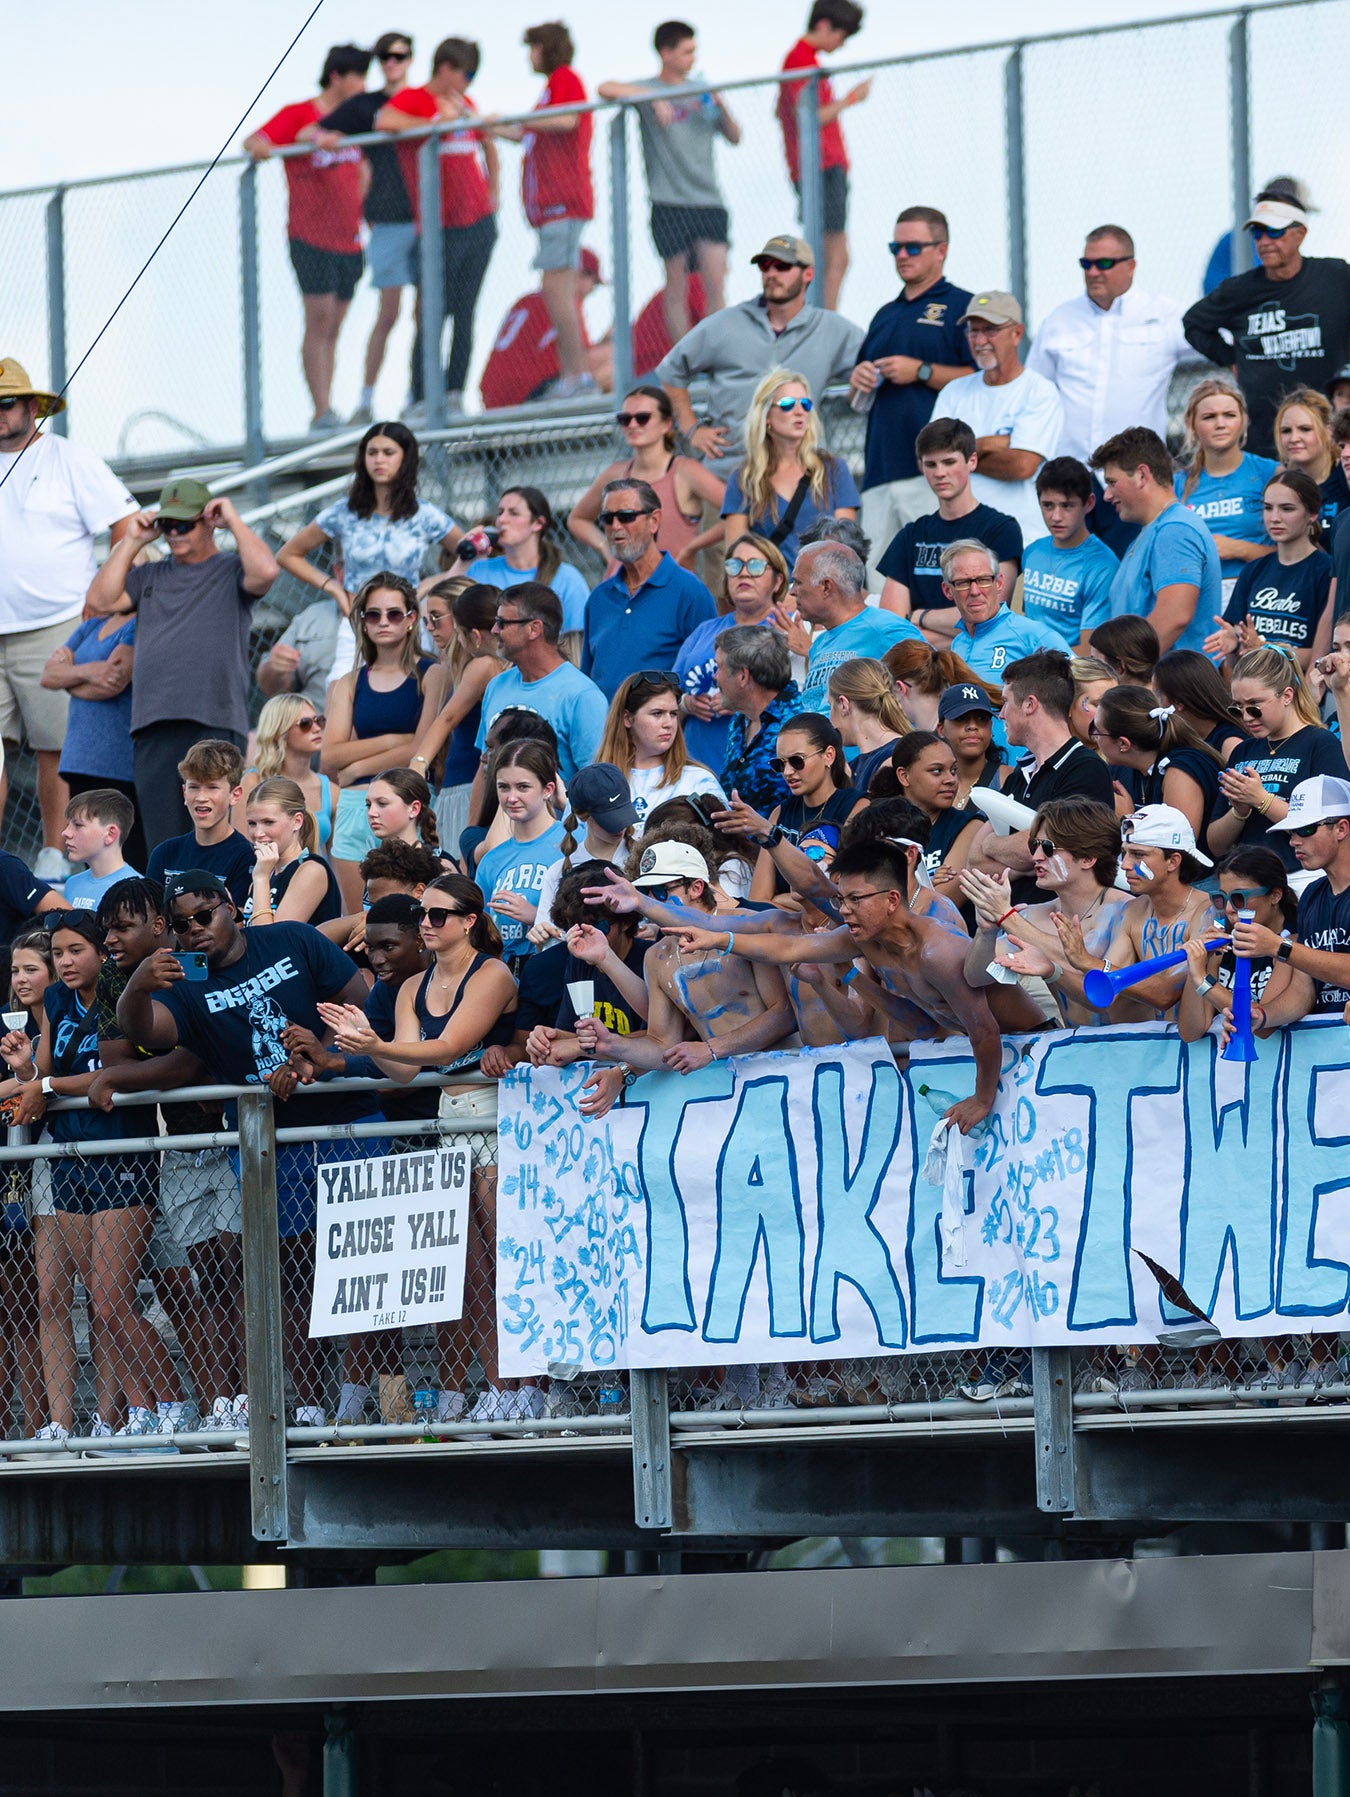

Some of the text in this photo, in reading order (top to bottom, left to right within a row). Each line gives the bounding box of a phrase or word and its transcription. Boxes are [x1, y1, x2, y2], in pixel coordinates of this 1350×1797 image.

[1251, 616, 1308, 640] UEBELLES
[990, 646, 1005, 669] B
[961, 686, 979, 700] NY
[1261, 774, 1289, 783] SEBALL
[1171, 832, 1181, 845] FJ
[204, 956, 300, 1014] BARBE
[501, 1065, 533, 1105] #4
[498, 1110, 533, 1151] #6
[531, 1090, 564, 1136] #7
[381, 1154, 436, 1198] HATE
[440, 1151, 467, 1190] US
[544, 1123, 585, 1180] #20
[500, 1163, 540, 1210] #14
[610, 1056, 985, 1349] TAKE
[327, 1208, 460, 1260] CAUSE YALL
[980, 1185, 1014, 1248] #5
[1015, 1205, 1061, 1264] #23
[498, 1235, 546, 1291] #24
[330, 1264, 448, 1316] AIN'T US!!!
[372, 1310, 408, 1327] TAKE 12
[501, 1293, 546, 1354] #34
[542, 1319, 585, 1366] #35
